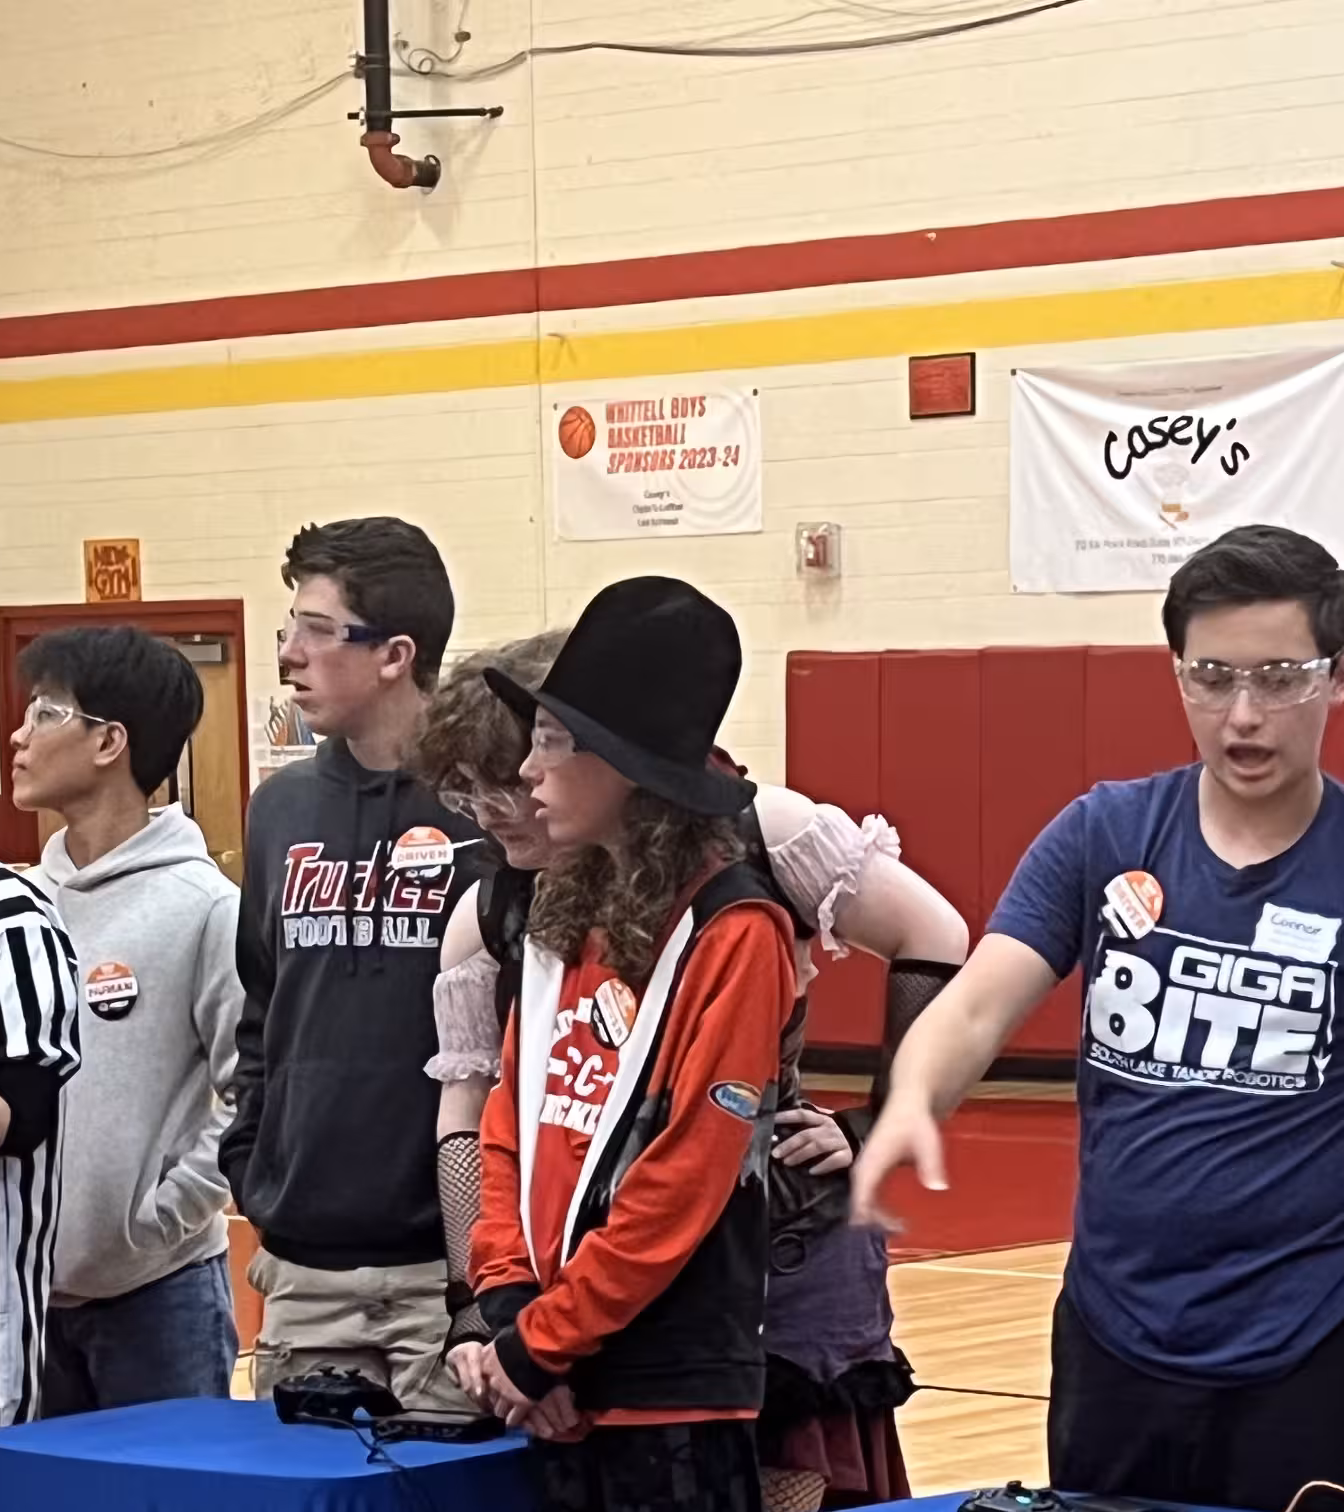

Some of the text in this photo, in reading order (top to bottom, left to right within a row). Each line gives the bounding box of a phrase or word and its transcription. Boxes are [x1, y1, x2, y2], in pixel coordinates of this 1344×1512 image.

[606, 395, 707, 424] WHITTELL BOYS
[607, 423, 687, 449] BASKETBALL
[606, 445, 741, 474] SPONSORS 2023-24
[283, 914, 439, 949] FOOTBALL
[1168, 945, 1327, 1009] GIGA
[1089, 948, 1323, 1075] BITE
[1129, 1060, 1167, 1078] LAKE
[1221, 1067, 1307, 1089] ROBOTICS
